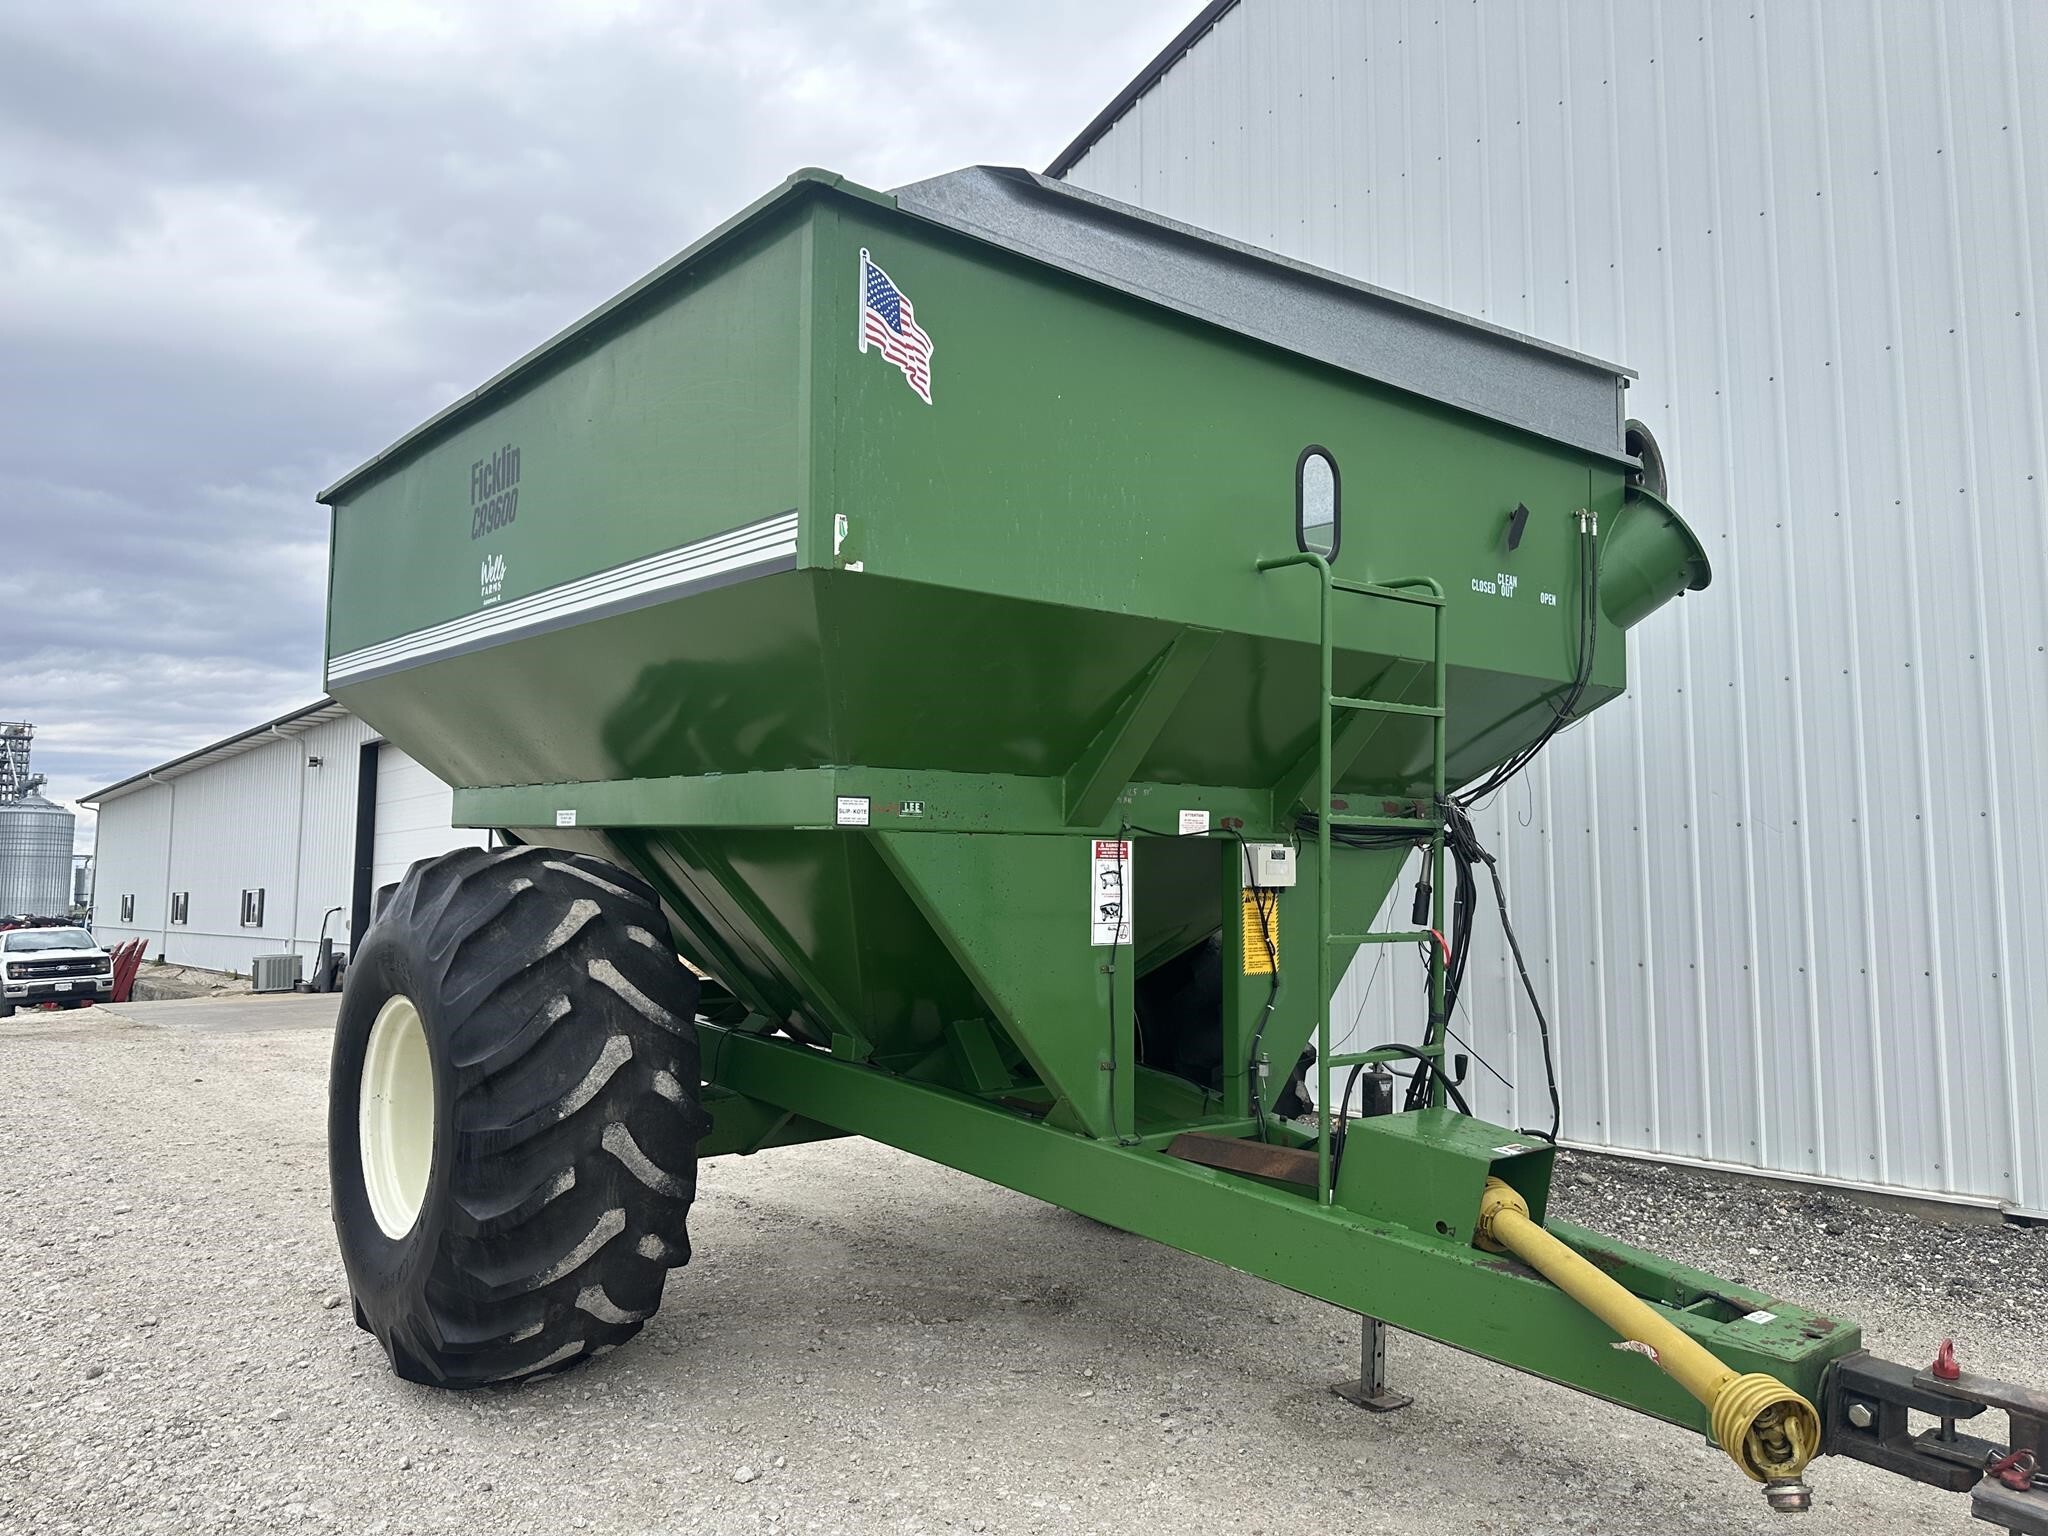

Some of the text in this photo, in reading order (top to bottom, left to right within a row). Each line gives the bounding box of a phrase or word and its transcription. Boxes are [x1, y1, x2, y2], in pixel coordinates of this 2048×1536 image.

[471, 444, 520, 505] Ficklin
[480, 554, 507, 586] Wells
[1472, 578, 1495, 594] CLOSED
[1498, 573, 1517, 587] CLEAN
[481, 582, 502, 597] FARMS
[1500, 585, 1514, 598] OUT
[1540, 592, 1557, 606] OPEN
